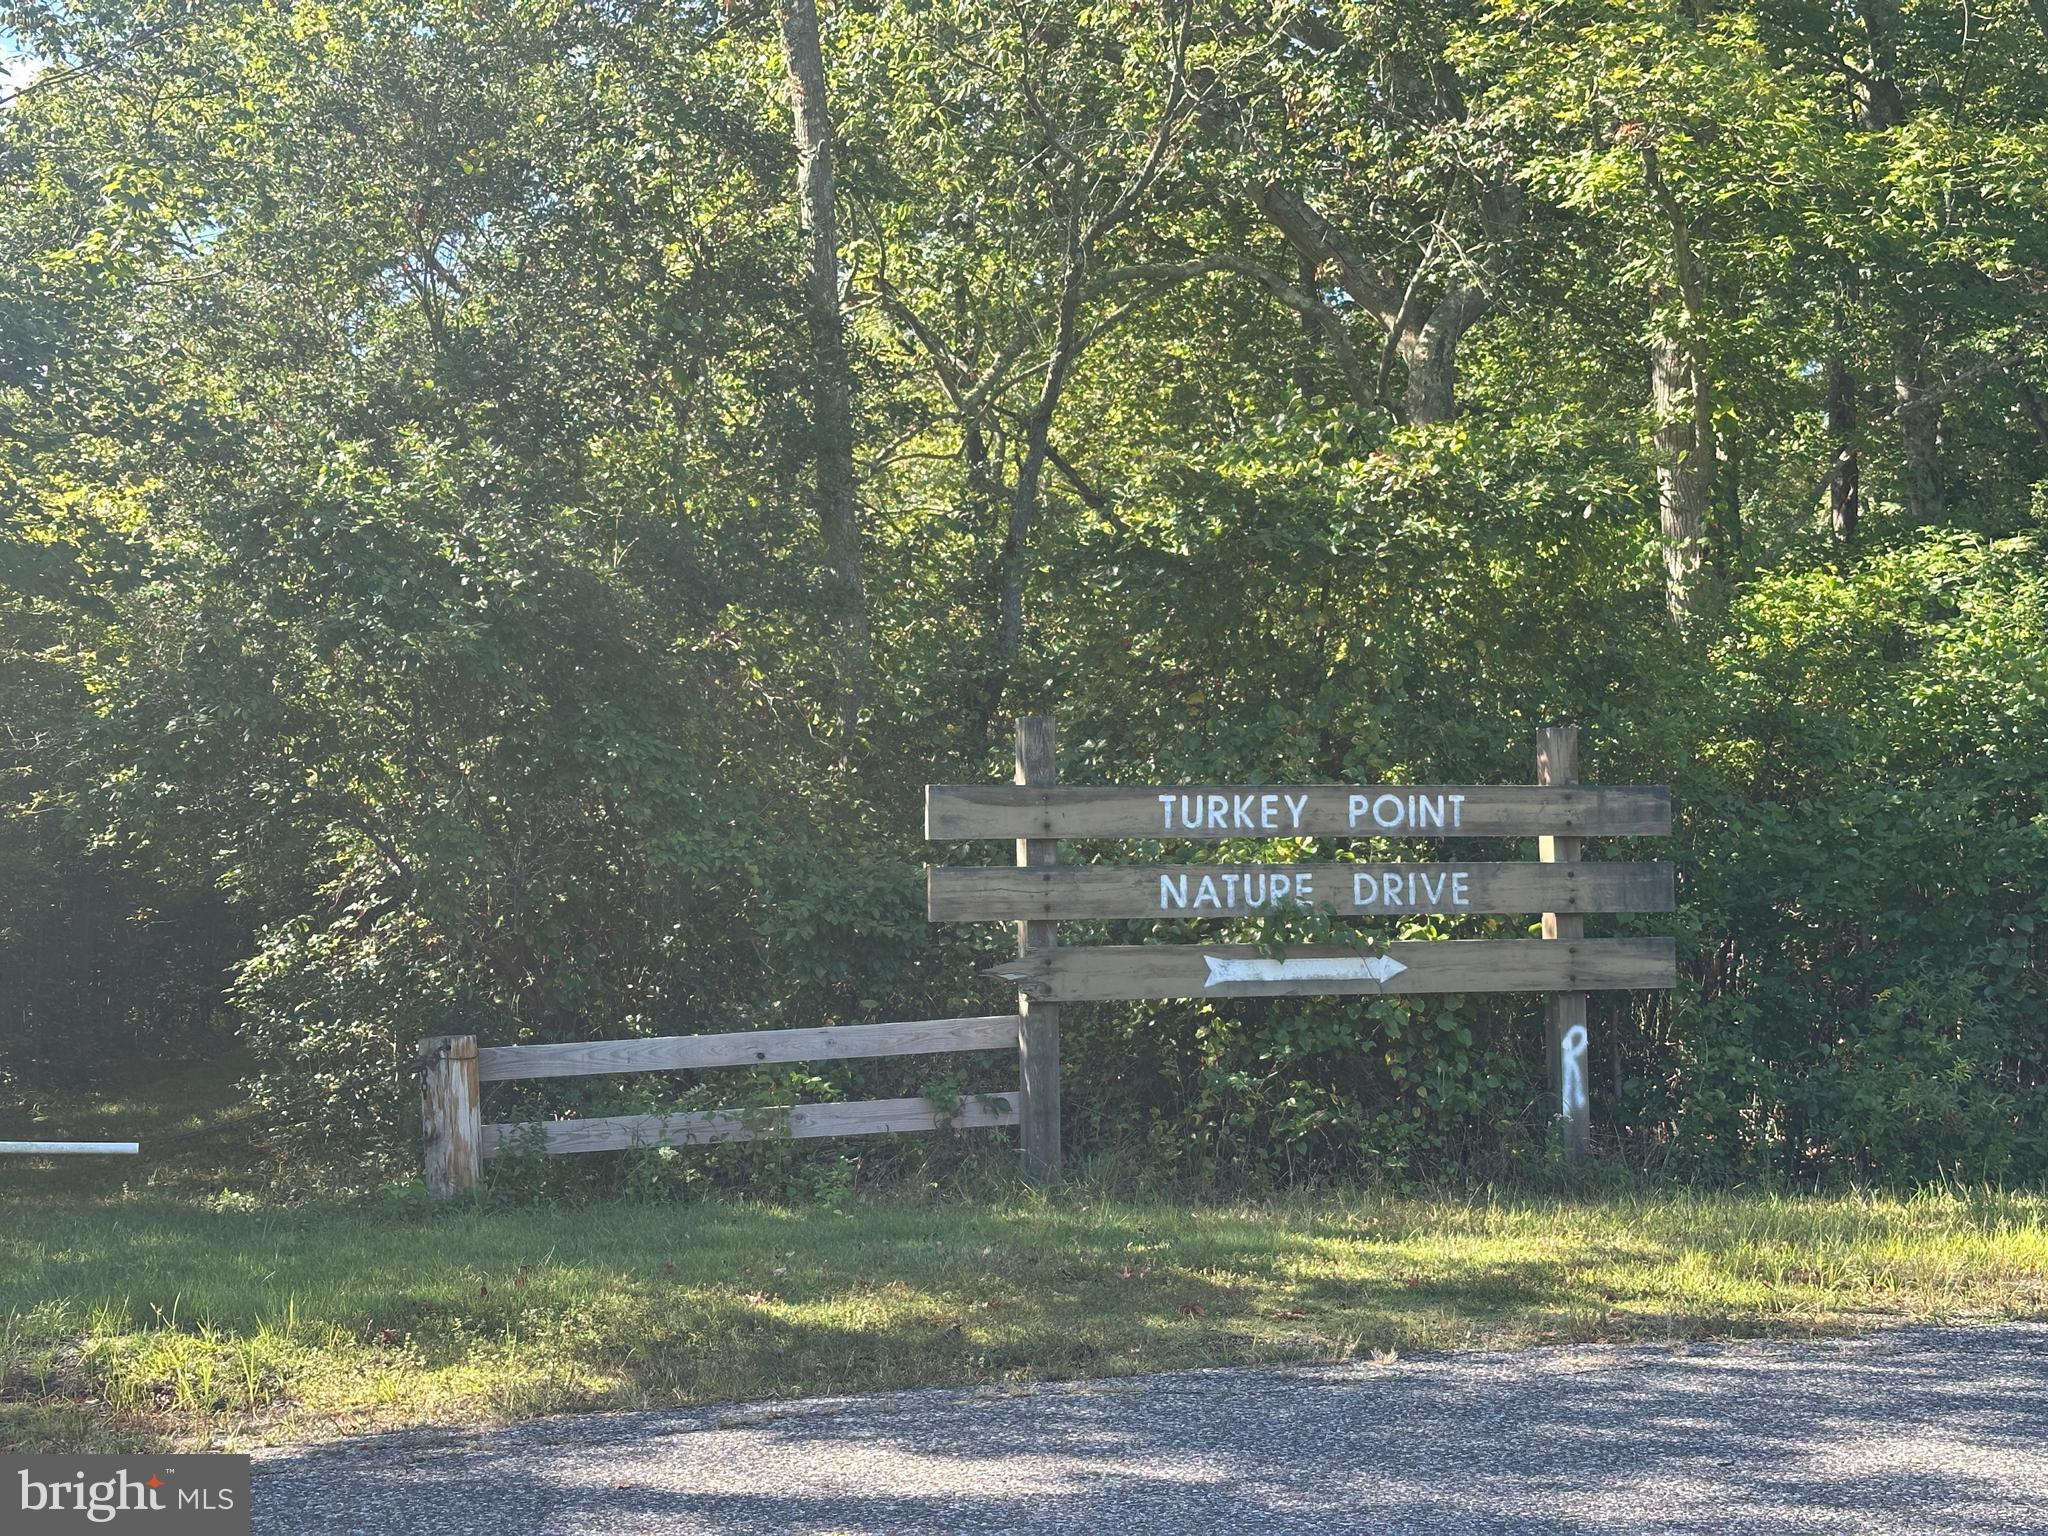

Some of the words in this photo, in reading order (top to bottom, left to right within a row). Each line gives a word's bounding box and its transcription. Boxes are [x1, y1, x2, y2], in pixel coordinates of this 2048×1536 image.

[1158, 794, 1308, 830] TURKEY
[1348, 794, 1466, 829] POINT
[1159, 872, 1314, 910] NATURE
[1353, 872, 1470, 907] DRIVE
